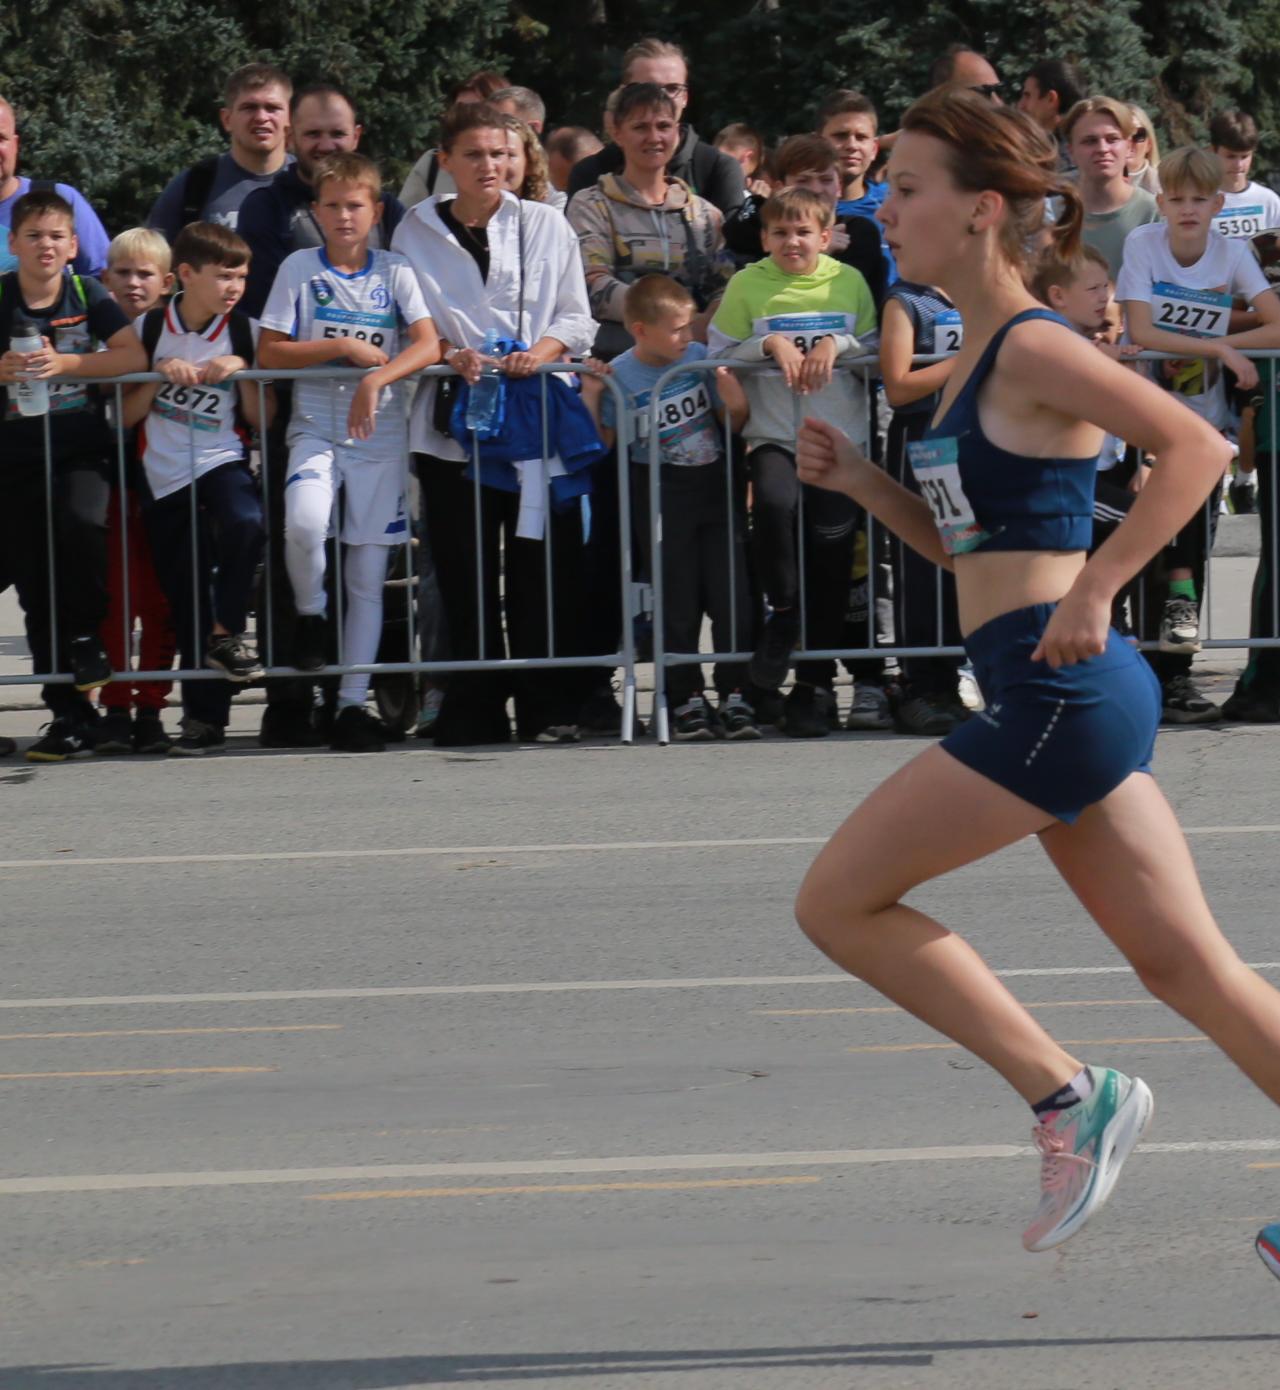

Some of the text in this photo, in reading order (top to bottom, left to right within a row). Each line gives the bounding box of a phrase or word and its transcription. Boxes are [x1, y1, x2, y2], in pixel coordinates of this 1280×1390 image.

[1218, 218, 1260, 236] 5301
[1159, 302, 1222, 330] 2277
[159, 381, 220, 415] 2672
